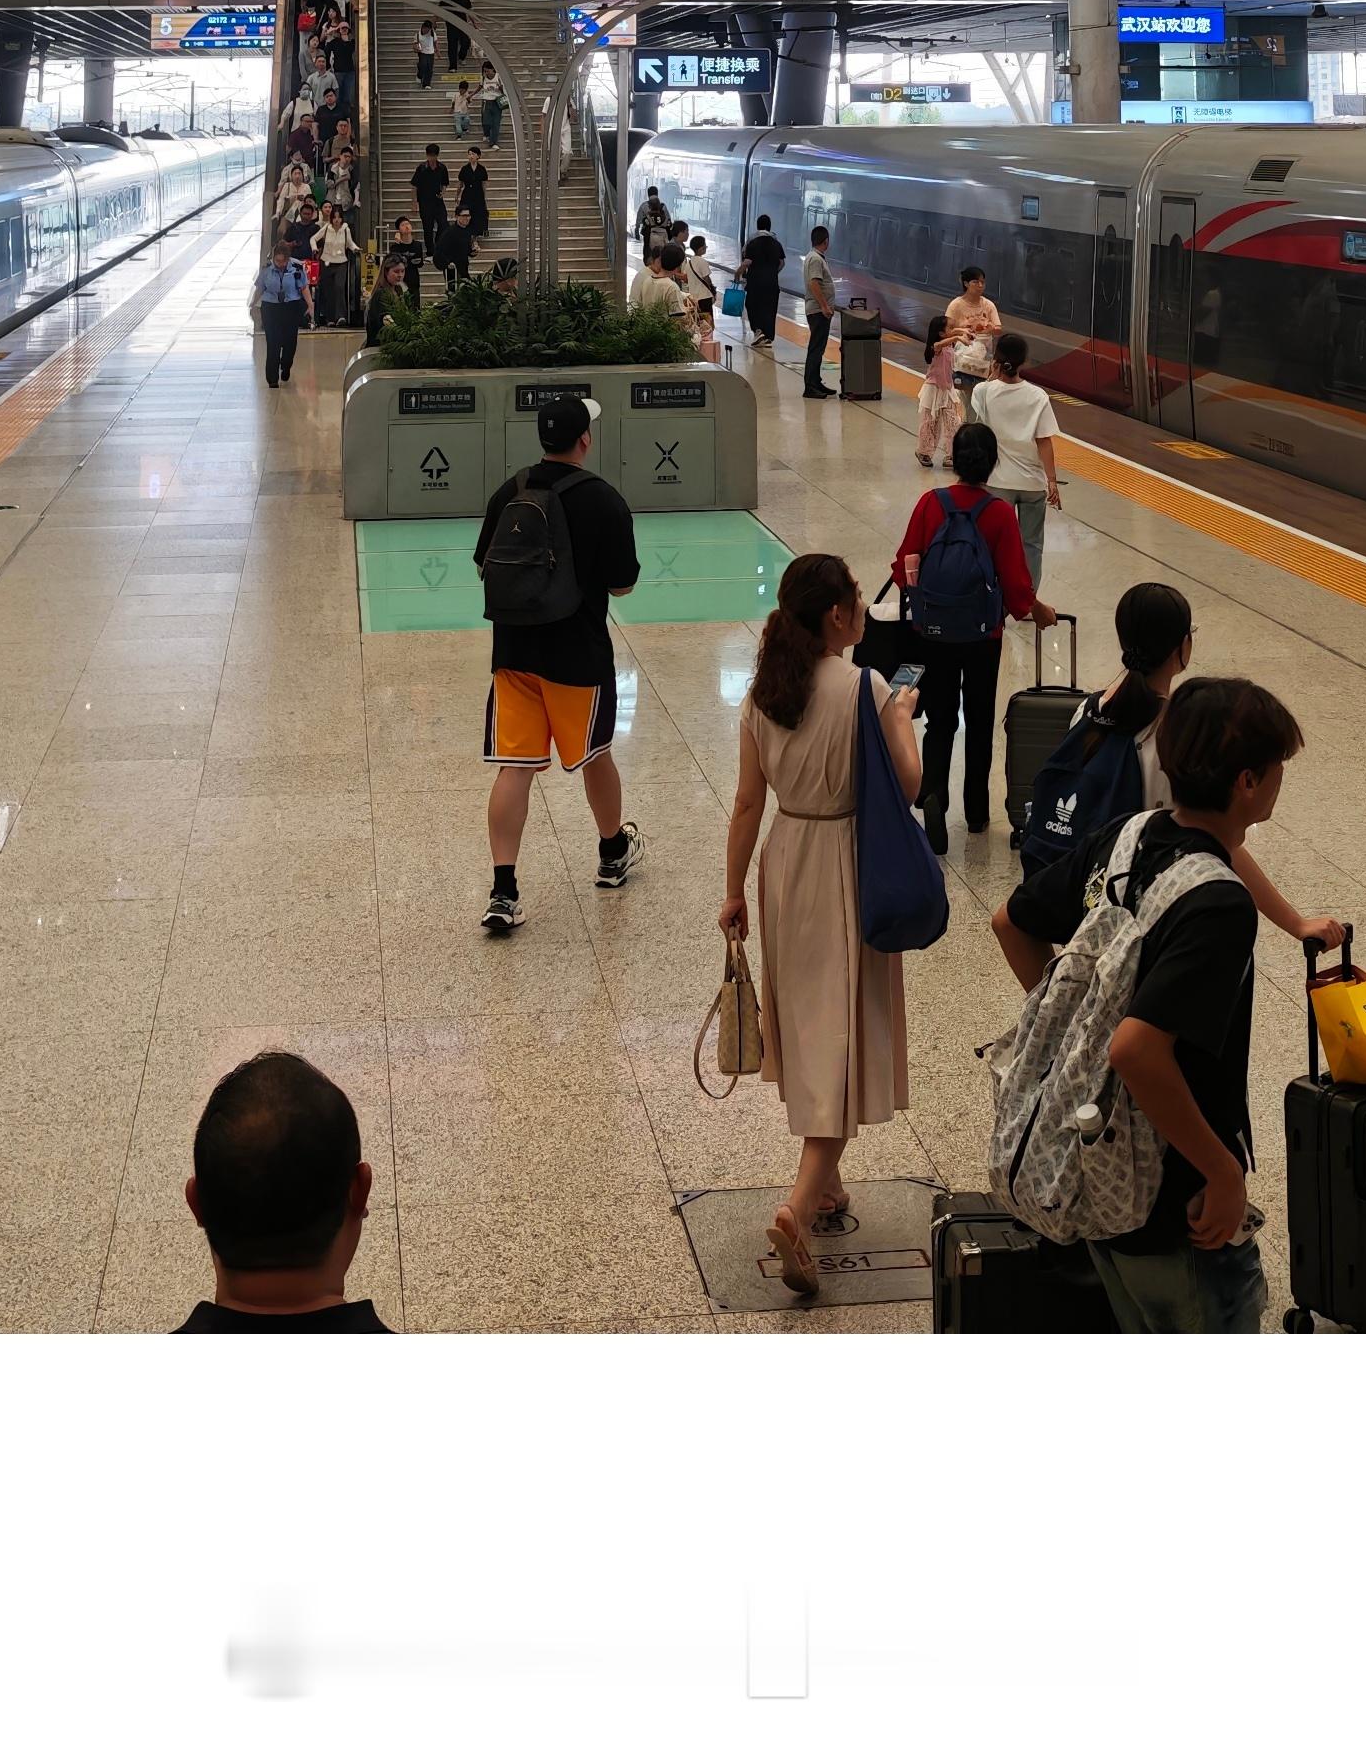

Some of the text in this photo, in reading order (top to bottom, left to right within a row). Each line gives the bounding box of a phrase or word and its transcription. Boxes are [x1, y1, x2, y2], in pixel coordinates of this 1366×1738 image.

[160, 17, 173, 36] 5
[1120, 17, 1211, 34] 武汉站欢迎您
[700, 57, 760, 73] 便捷换乘
[700, 73, 745, 86] Transfer
[883, 87, 902, 100] D2
